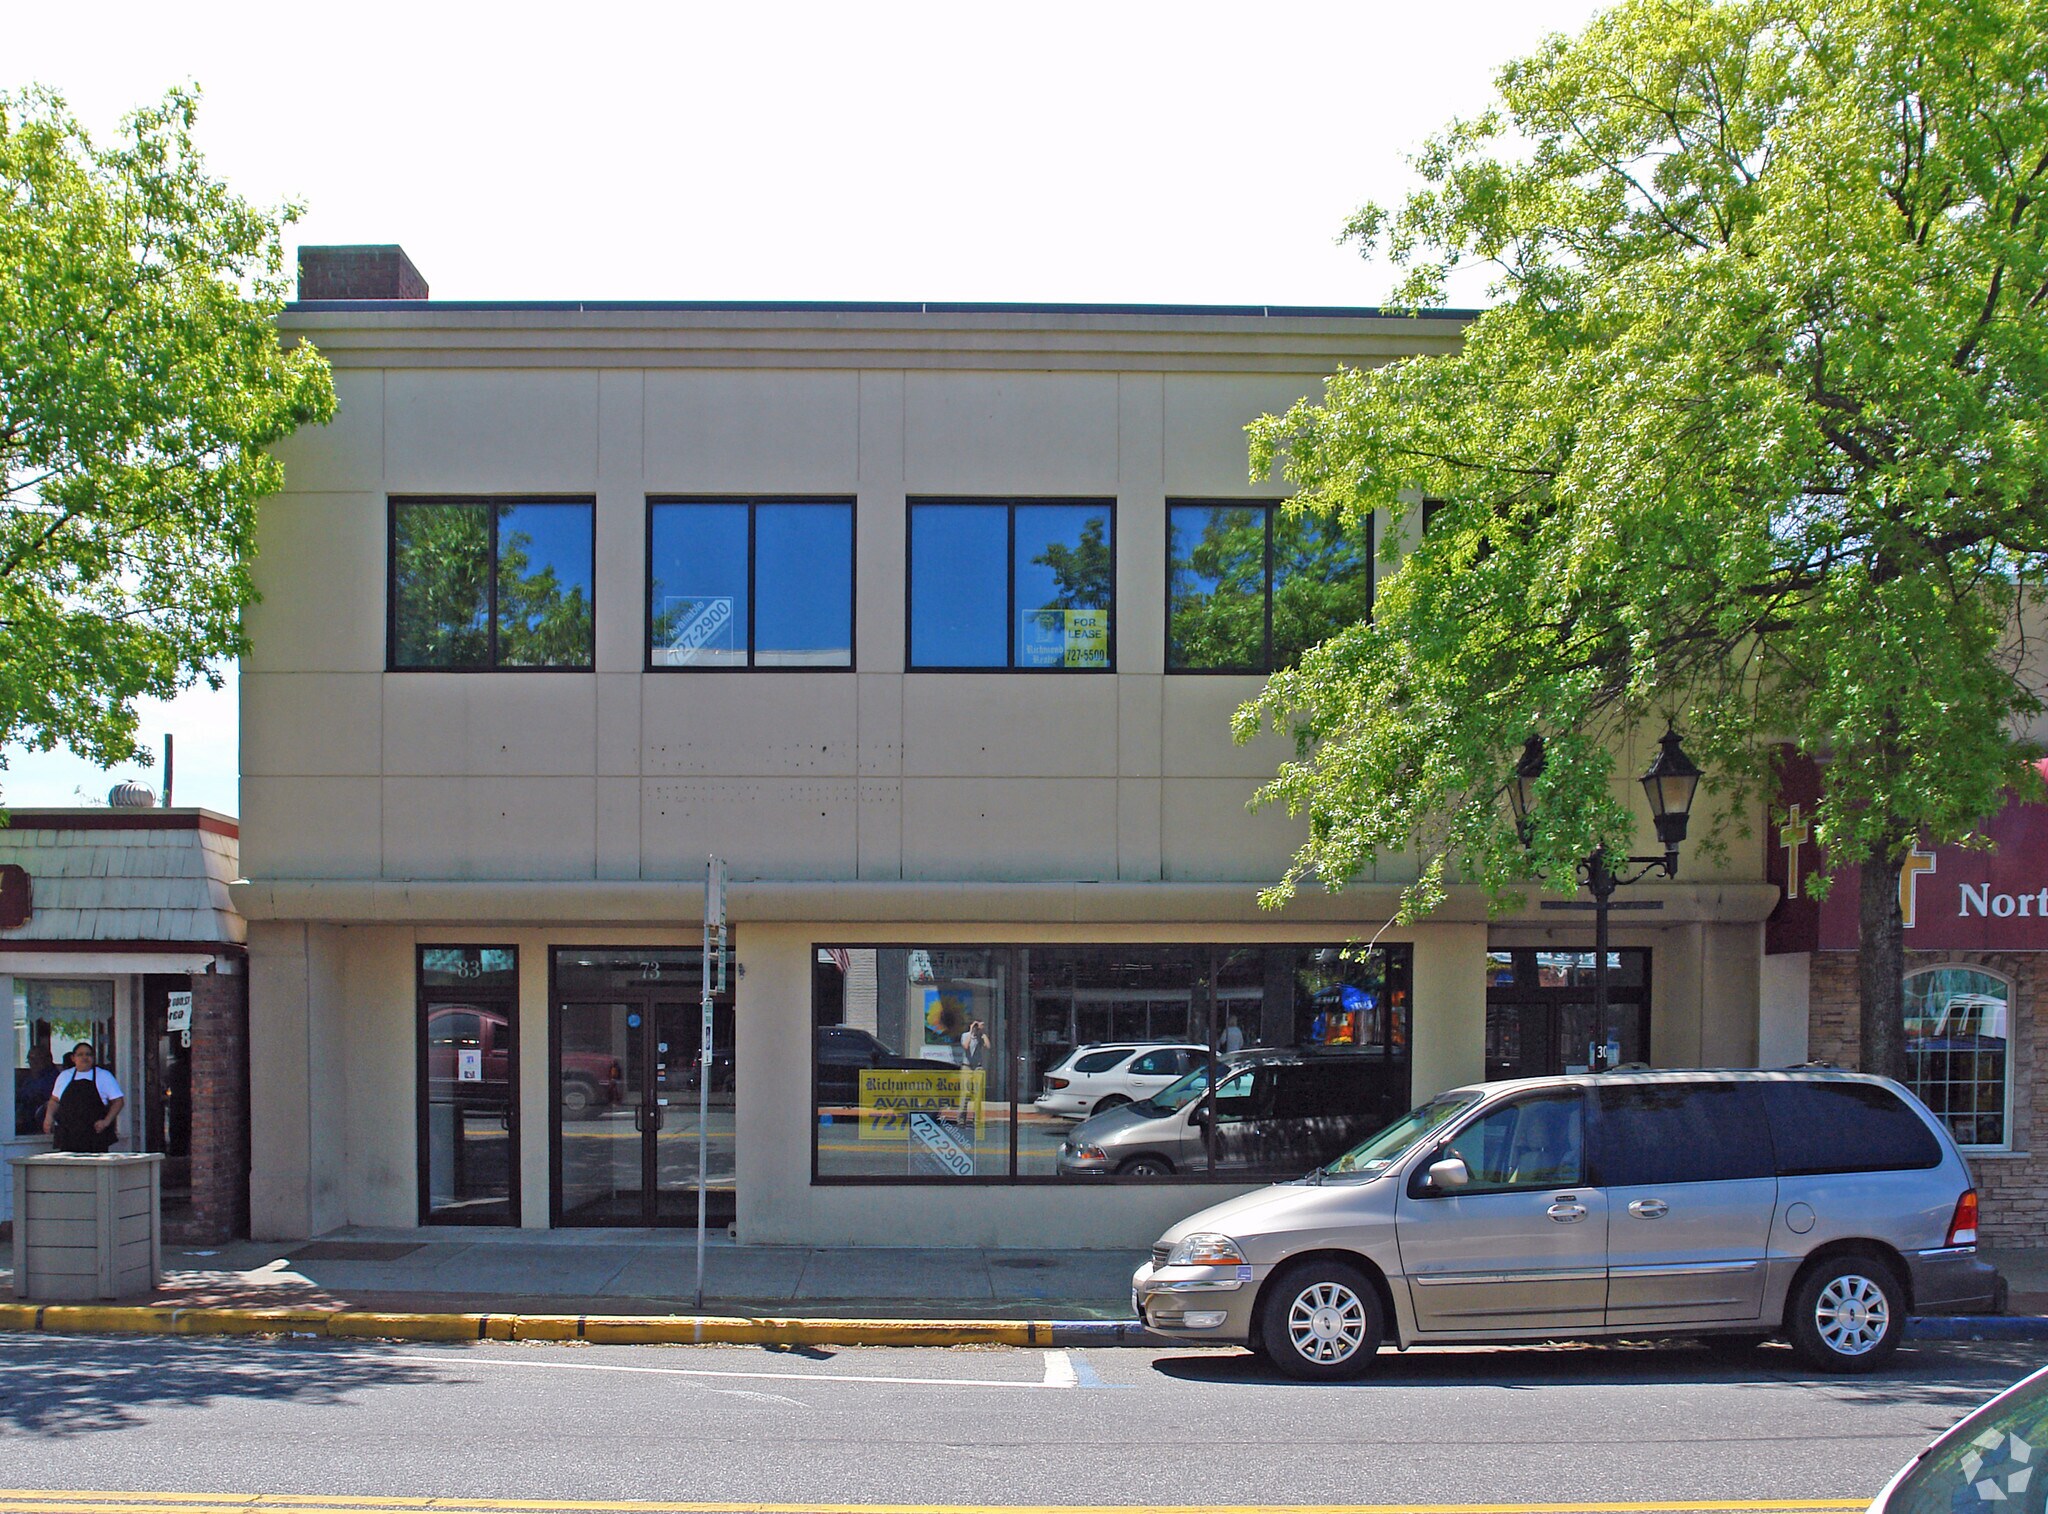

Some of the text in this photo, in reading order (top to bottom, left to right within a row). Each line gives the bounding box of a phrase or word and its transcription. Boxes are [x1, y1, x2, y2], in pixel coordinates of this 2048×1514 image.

[668, 601, 704, 638] Available
[1074, 618, 1096, 627] FOR
[670, 601, 729, 664] 727-2900
[1068, 629, 1102, 639] LEASE
[1958, 882, 2048, 918] Nort
[457, 960, 480, 978] 83
[640, 961, 660, 980] 73
[866, 1077, 932, 1093] Richmond
[874, 1097, 971, 1108] AVAILABLE
[869, 1113, 909, 1131] 727
[936, 1115, 972, 1151] Available
[913, 1115, 972, 1175] 727-2900
